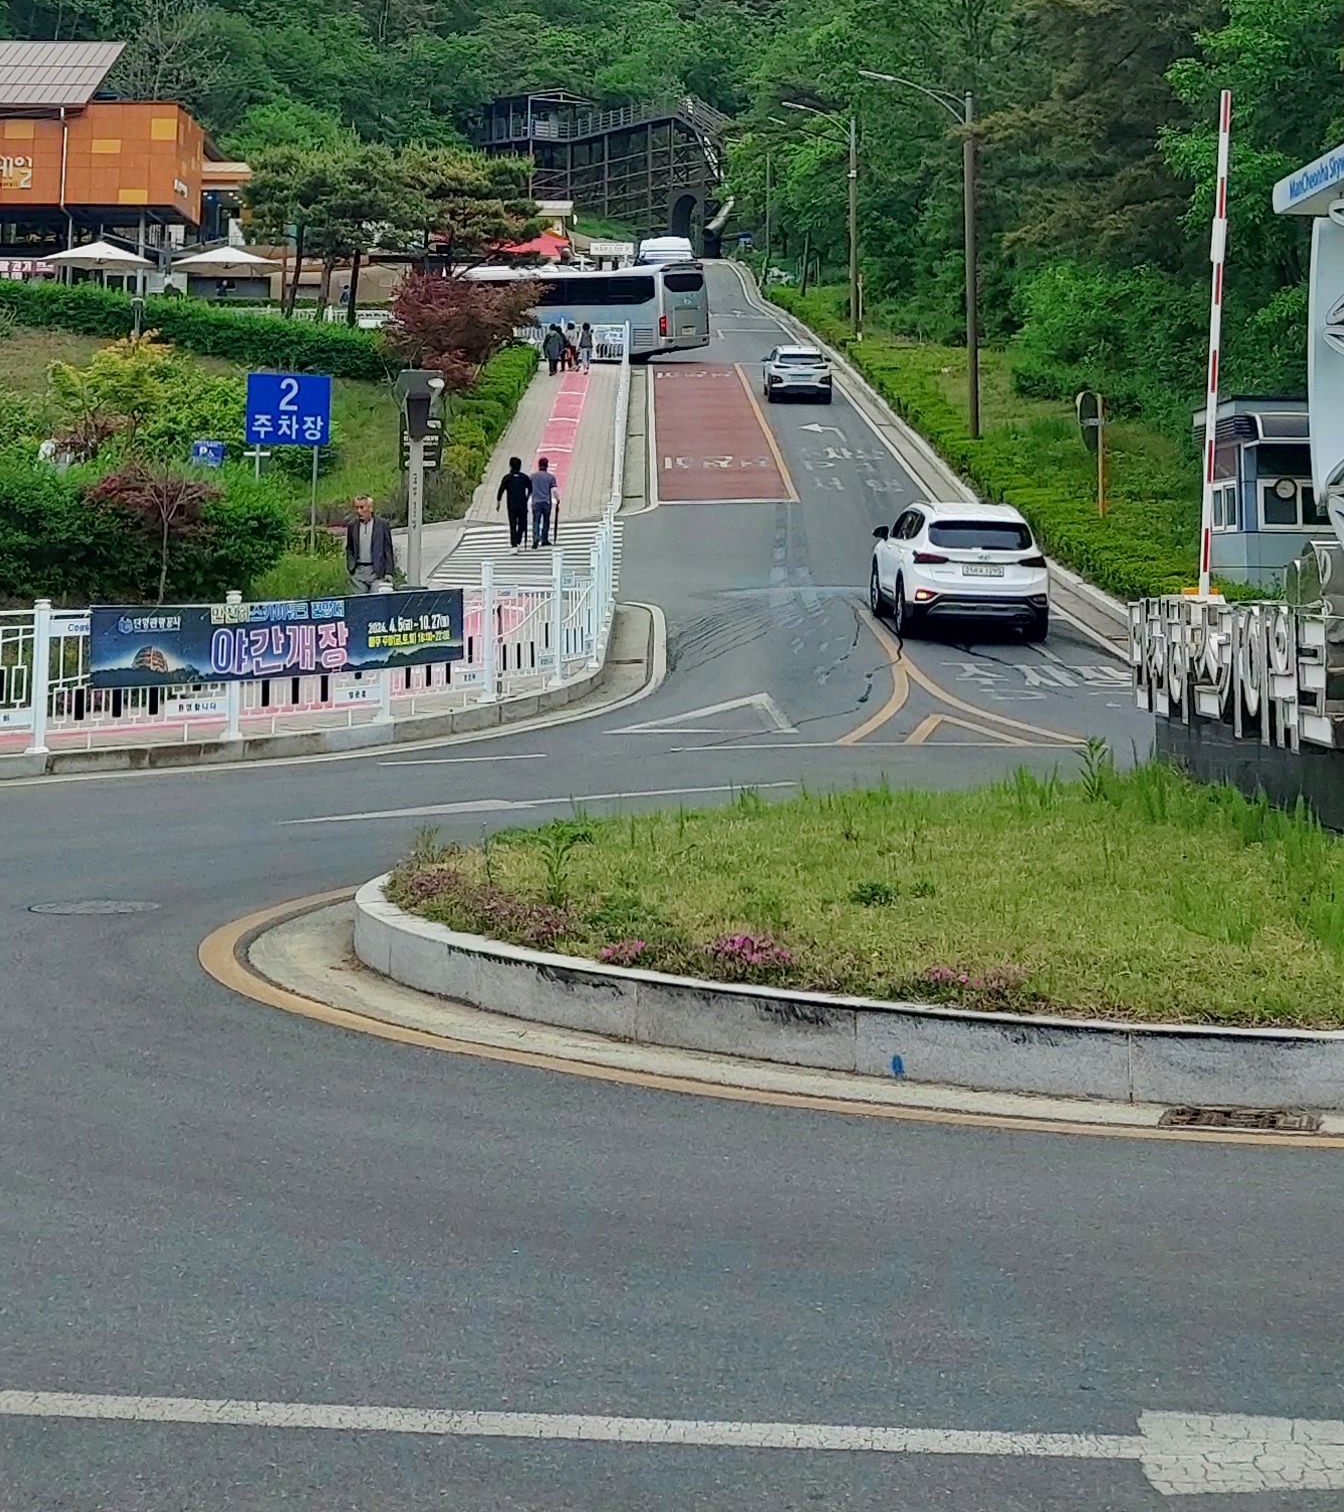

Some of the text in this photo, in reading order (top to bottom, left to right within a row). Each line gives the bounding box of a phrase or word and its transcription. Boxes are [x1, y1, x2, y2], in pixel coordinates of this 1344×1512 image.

[279, 378, 299, 411] 2
[252, 414, 324, 440] 주차장
[211, 621, 348, 675] 야간개장
